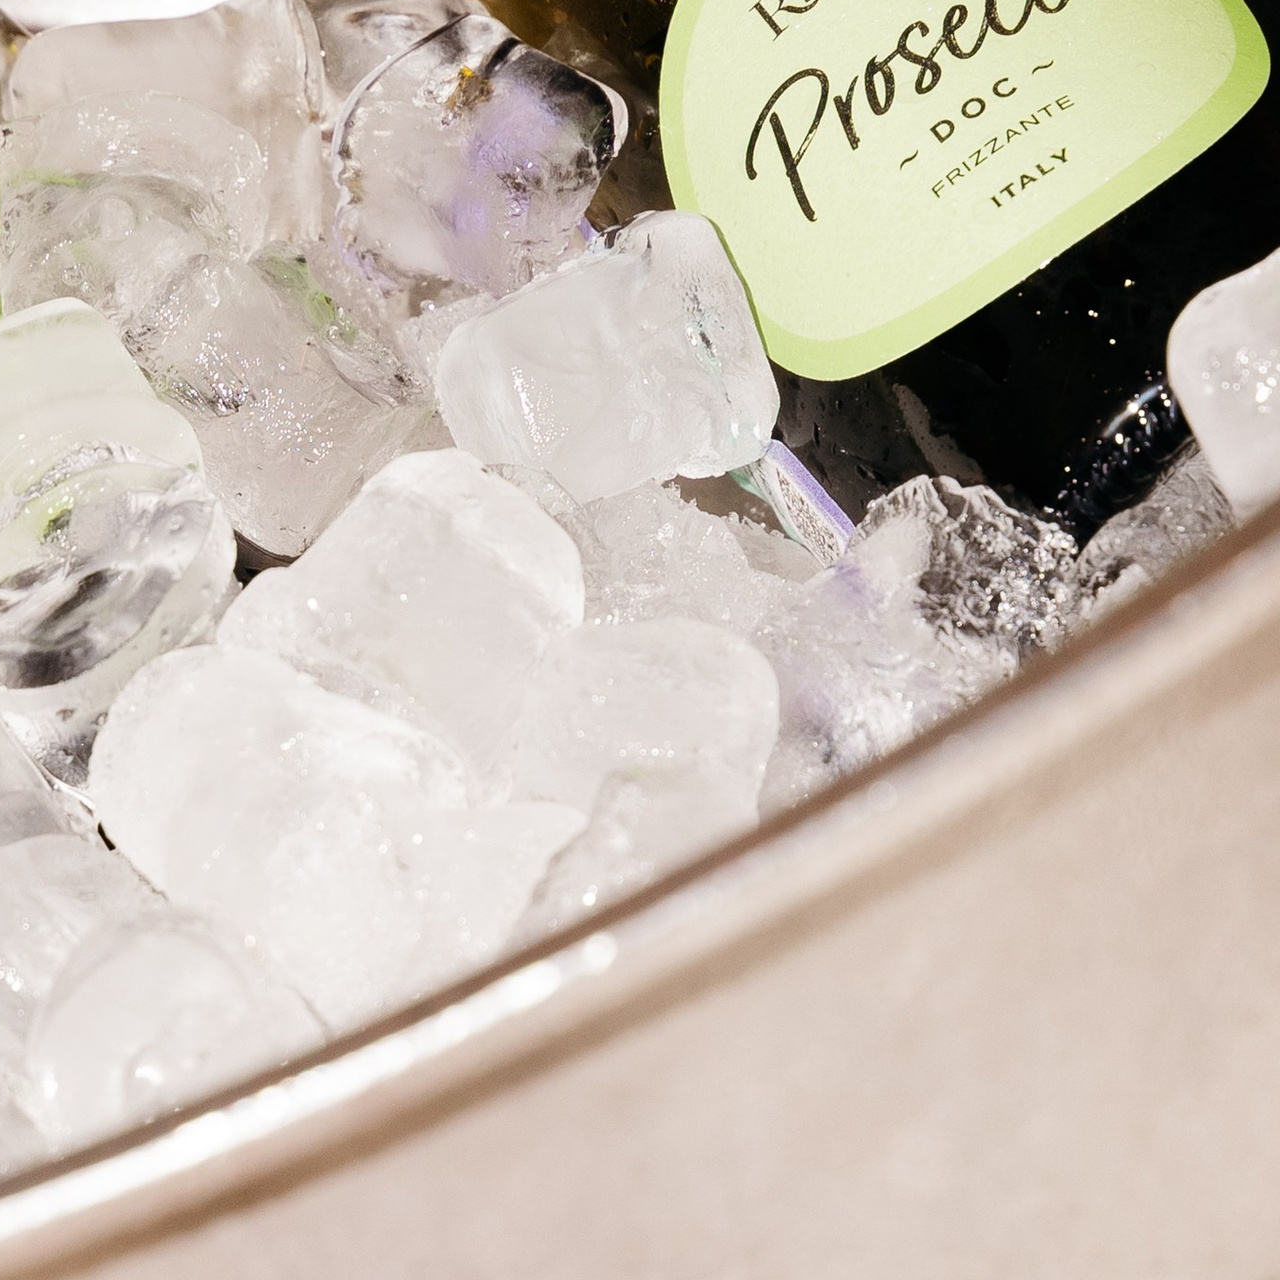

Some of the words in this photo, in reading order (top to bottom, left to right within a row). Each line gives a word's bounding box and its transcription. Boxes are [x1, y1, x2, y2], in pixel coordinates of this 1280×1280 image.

[930, 76, 1018, 144] DOC
[931, 95, 1075, 199] FRIZZANTE
[991, 147, 1071, 208] ITALY
